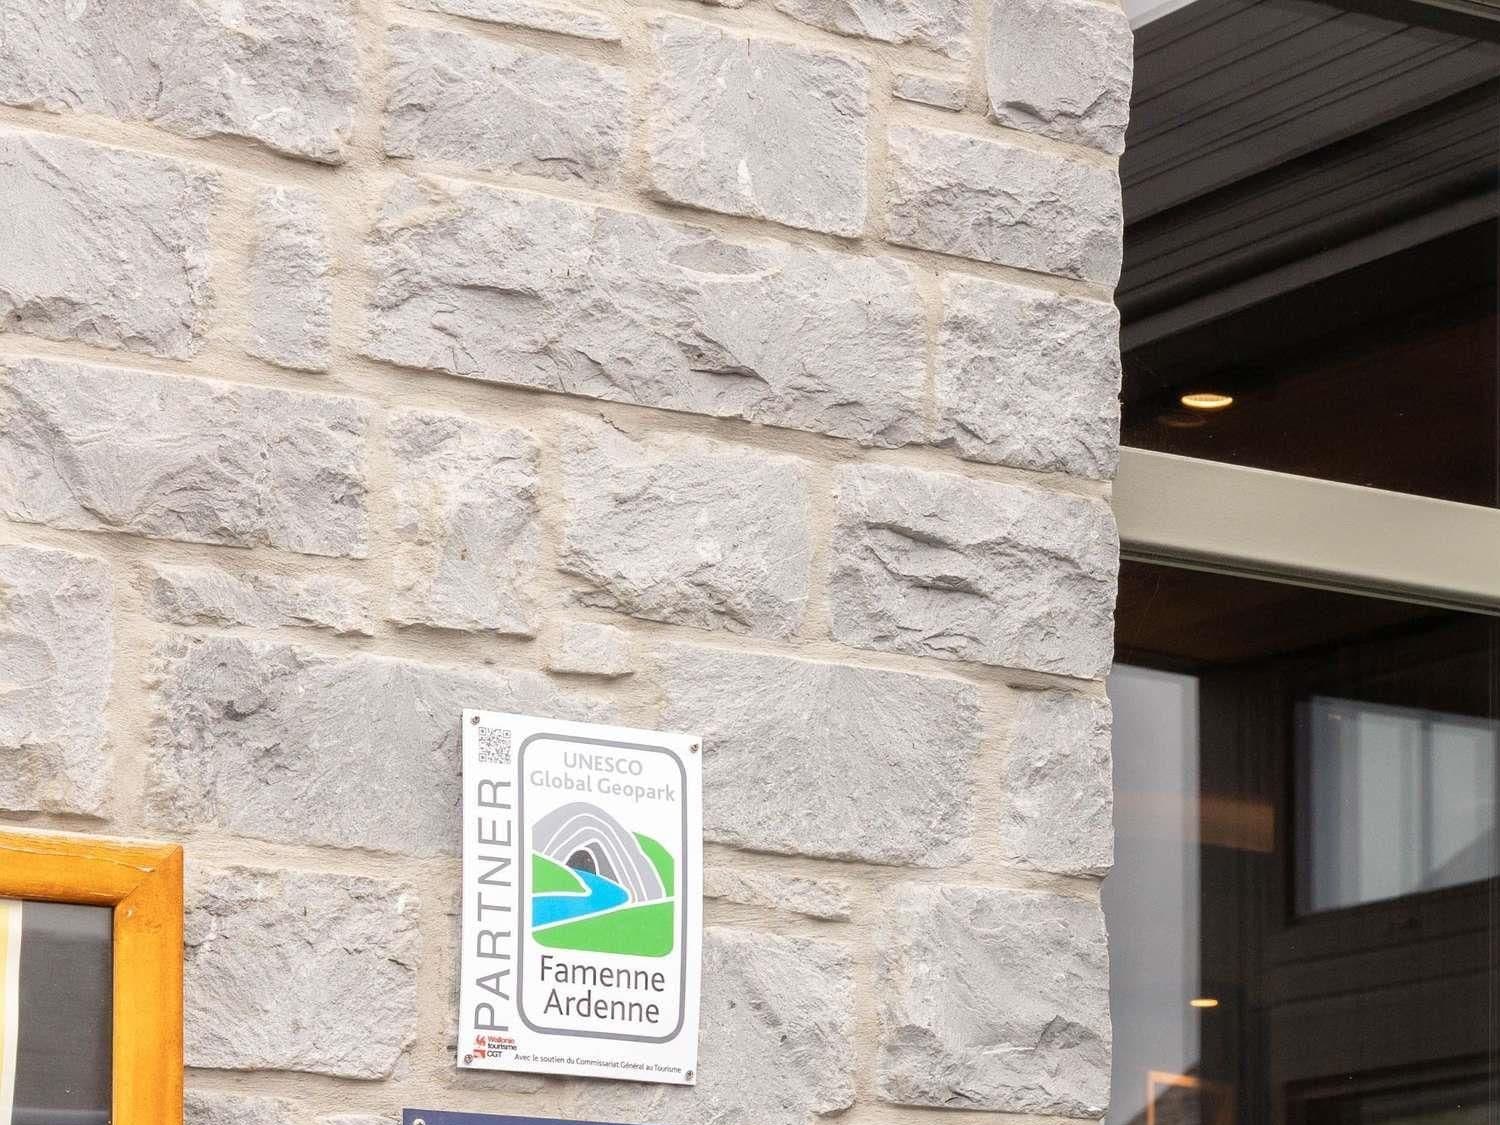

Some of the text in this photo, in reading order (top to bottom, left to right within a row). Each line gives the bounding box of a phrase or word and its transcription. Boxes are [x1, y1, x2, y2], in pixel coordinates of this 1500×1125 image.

[564, 751, 642, 776] UNESCO
[530, 770, 675, 803] Global Geopark
[474, 779, 511, 1031] PARTNER
[540, 954, 665, 993] Famenne
[543, 988, 660, 1023] Ardenne
[487, 1043, 517, 1051] tourisme
[514, 1053, 530, 1061] Avec
[540, 1055, 565, 1063] soutien
[566, 1056, 575, 1065] du
[576, 1057, 619, 1068] Commissariat
[654, 1064, 682, 1073] Tourisme
